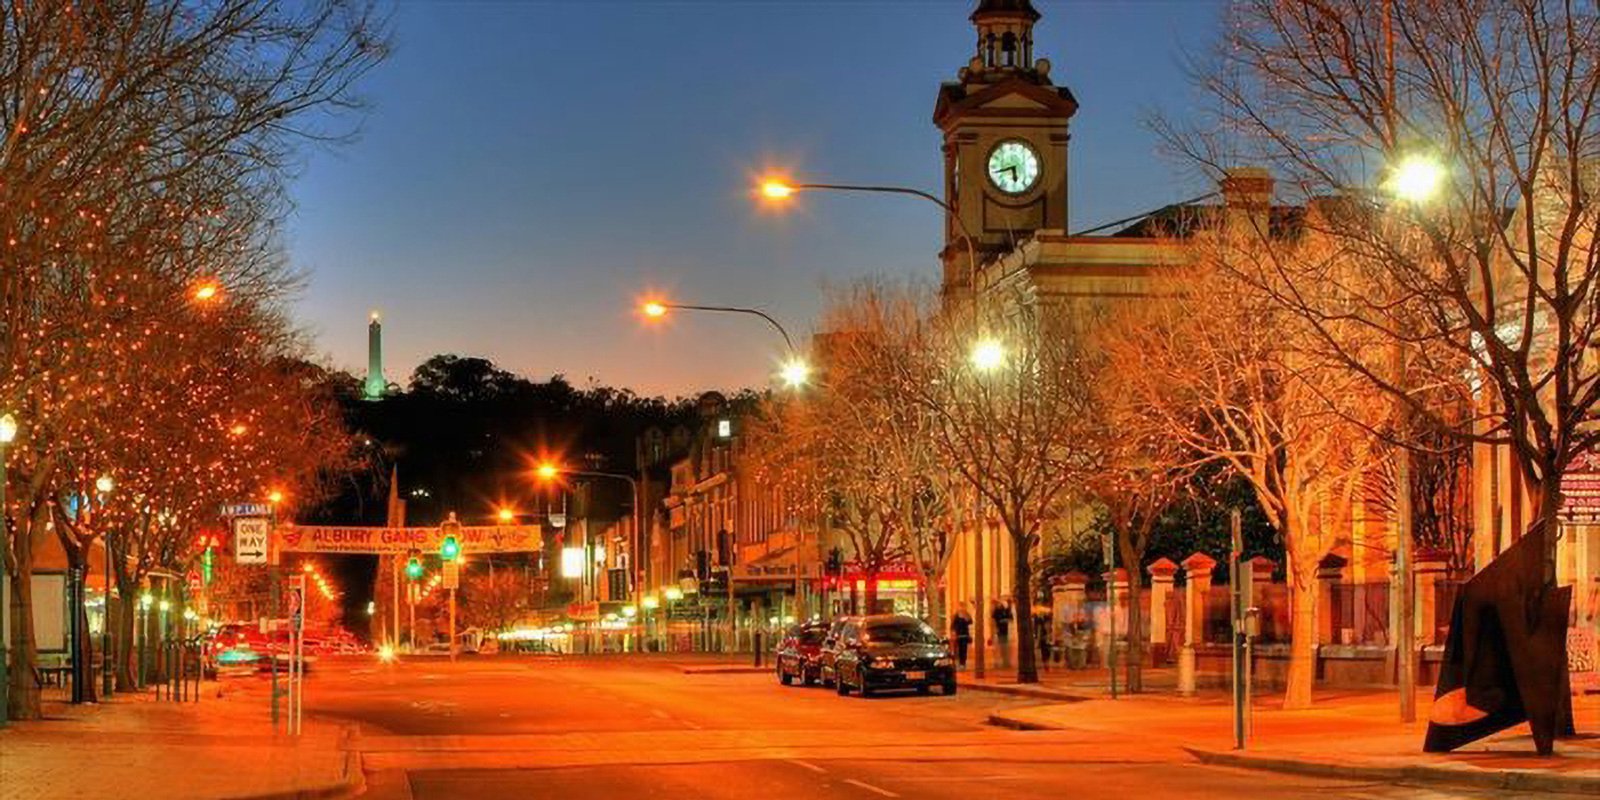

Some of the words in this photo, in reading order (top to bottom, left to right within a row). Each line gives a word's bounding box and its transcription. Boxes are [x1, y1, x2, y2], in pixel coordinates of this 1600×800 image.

[240, 523, 264, 535] ONE
[312, 528, 372, 543] ALBURY
[381, 529, 427, 544] GANG
[434, 529, 483, 543] SOW
[240, 537, 264, 548] WAY
